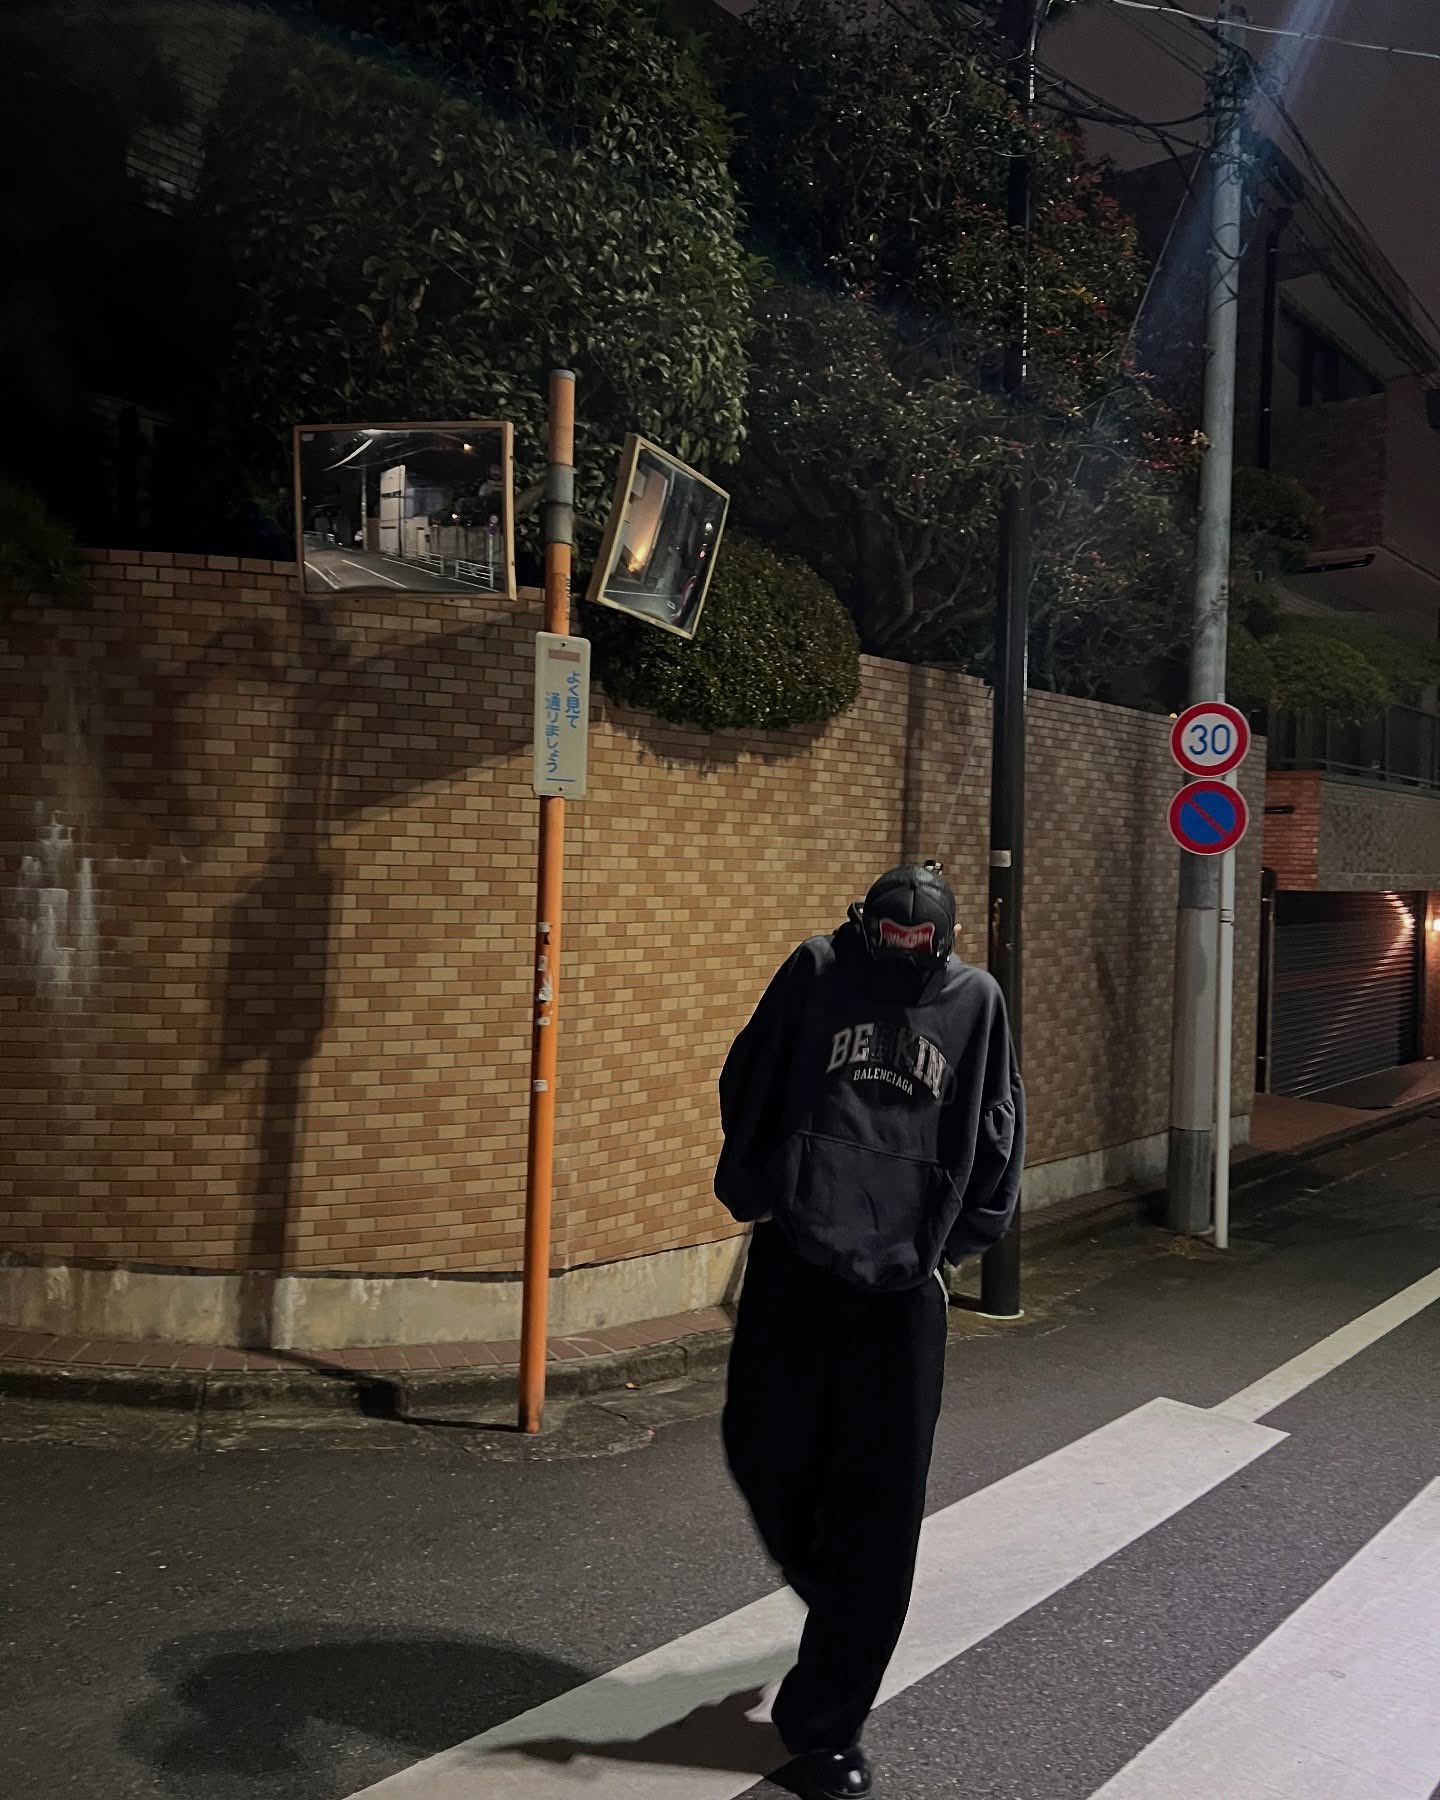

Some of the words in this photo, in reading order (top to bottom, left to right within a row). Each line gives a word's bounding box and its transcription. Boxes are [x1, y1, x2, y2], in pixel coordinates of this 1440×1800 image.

[565, 671, 580, 728] よく見て
[545, 691, 560, 773] 通りましょう
[1189, 723, 1230, 755] 30
[853, 1067, 913, 1096] BALENCIAGA
